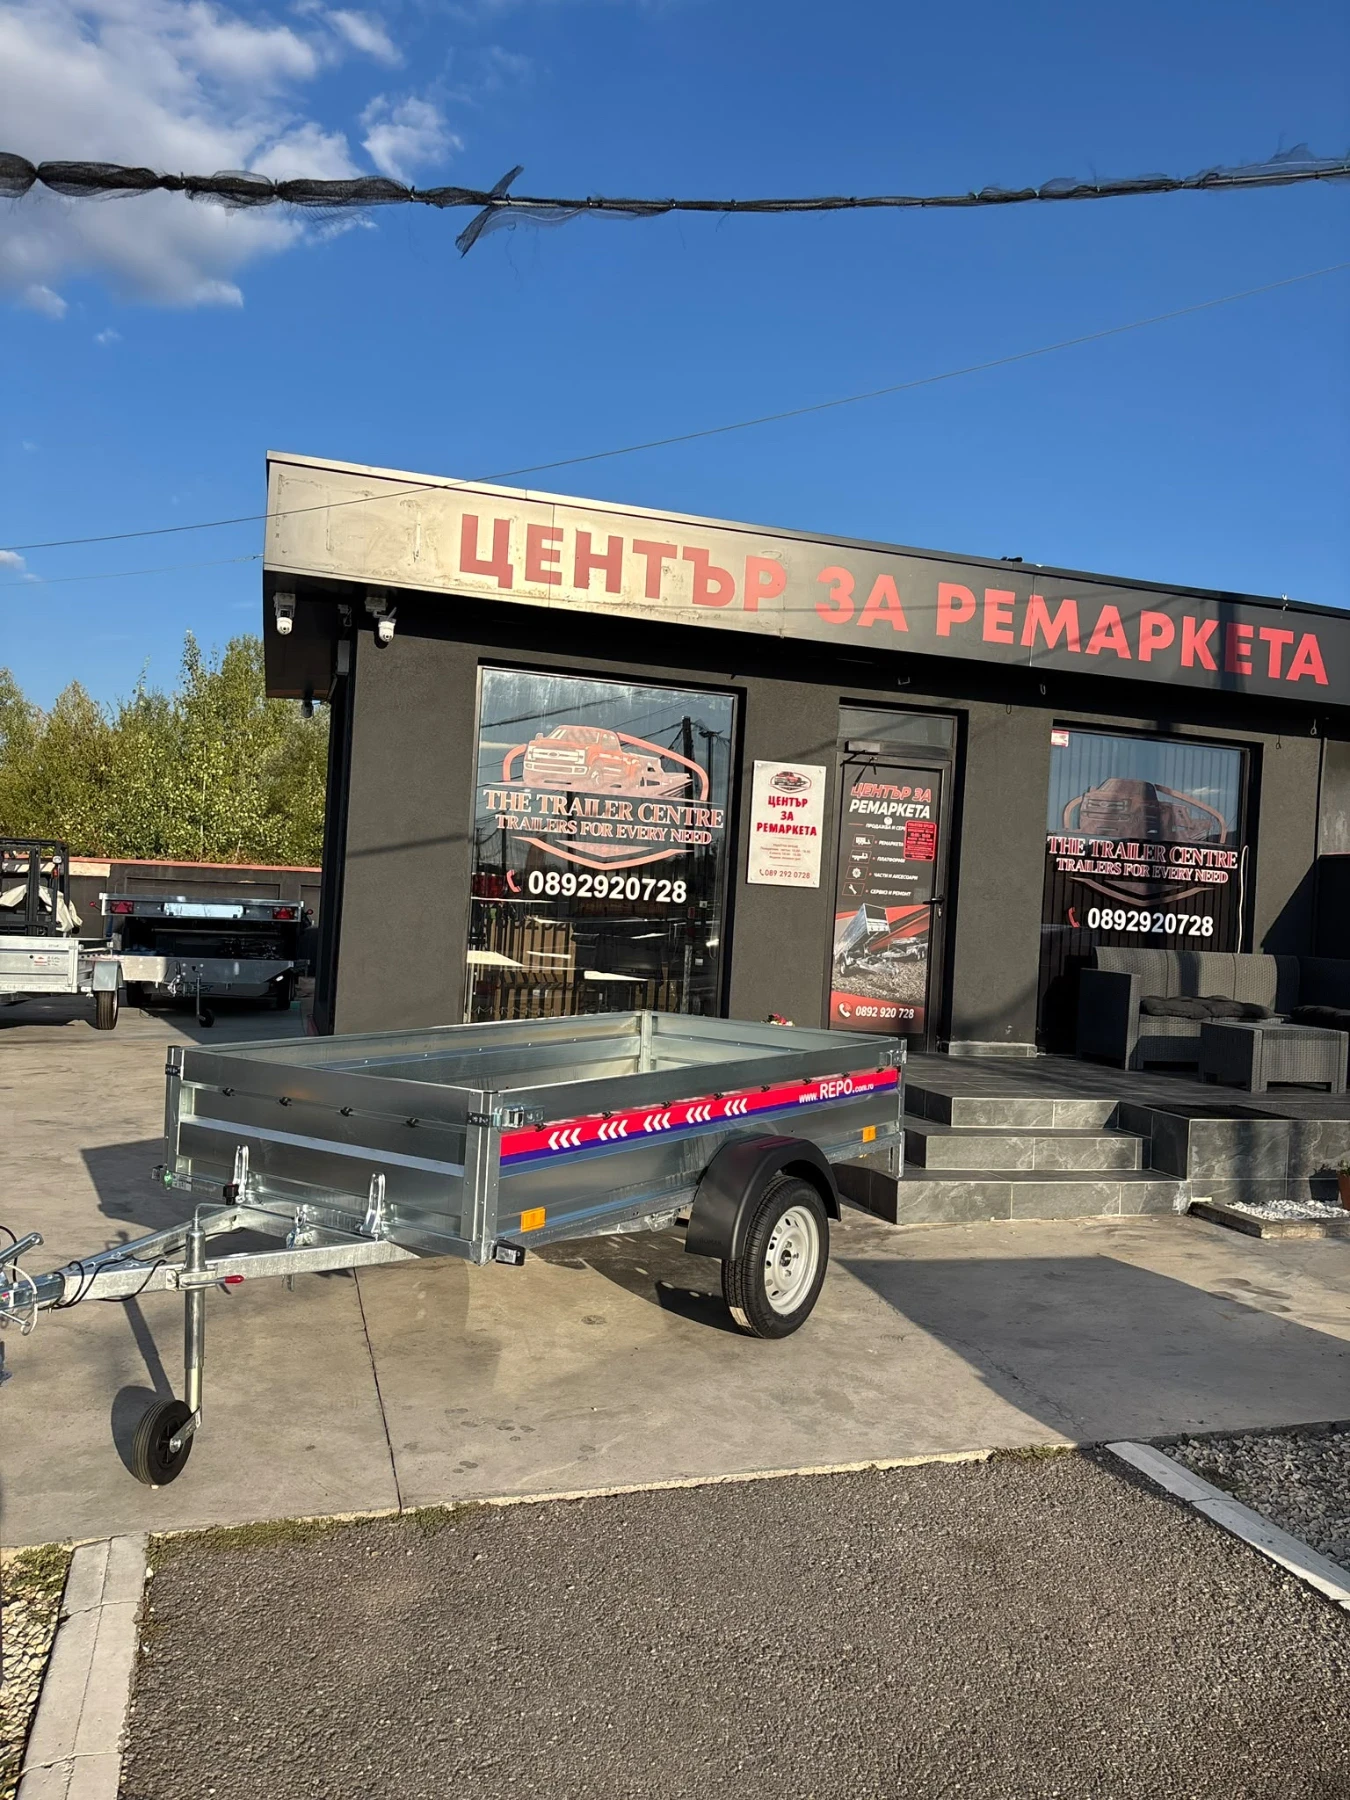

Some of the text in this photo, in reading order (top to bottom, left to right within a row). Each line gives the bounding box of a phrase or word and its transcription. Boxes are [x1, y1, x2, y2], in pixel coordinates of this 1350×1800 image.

[459, 513, 1329, 686] ЦЕНТЪР ЗА РЕМАРКЕТА
[768, 795, 808, 808] ЦЕНТЪР
[850, 782, 932, 803] ЦЕНТЪР ЗА
[483, 789, 724, 829] THE TRAILER CENTRE
[780, 811, 794, 821] ЗА
[849, 799, 930, 819] РЕМАРКЕТА
[495, 814, 712, 845] TRAILERS FOR EVERY NEED
[756, 822, 817, 836] РЕМАРКЕТА
[1047, 836, 1238, 869] THE TRAILER CENTRE
[779, 870, 792, 878] 292
[793, 871, 811, 879] 0728
[1056, 857, 1229, 884] TRAILERS FOR EVERY NEED
[528, 870, 687, 903] 0892920728
[1087, 907, 1214, 937] 0892920728
[855, 1005, 915, 1019] 0892 920 728
